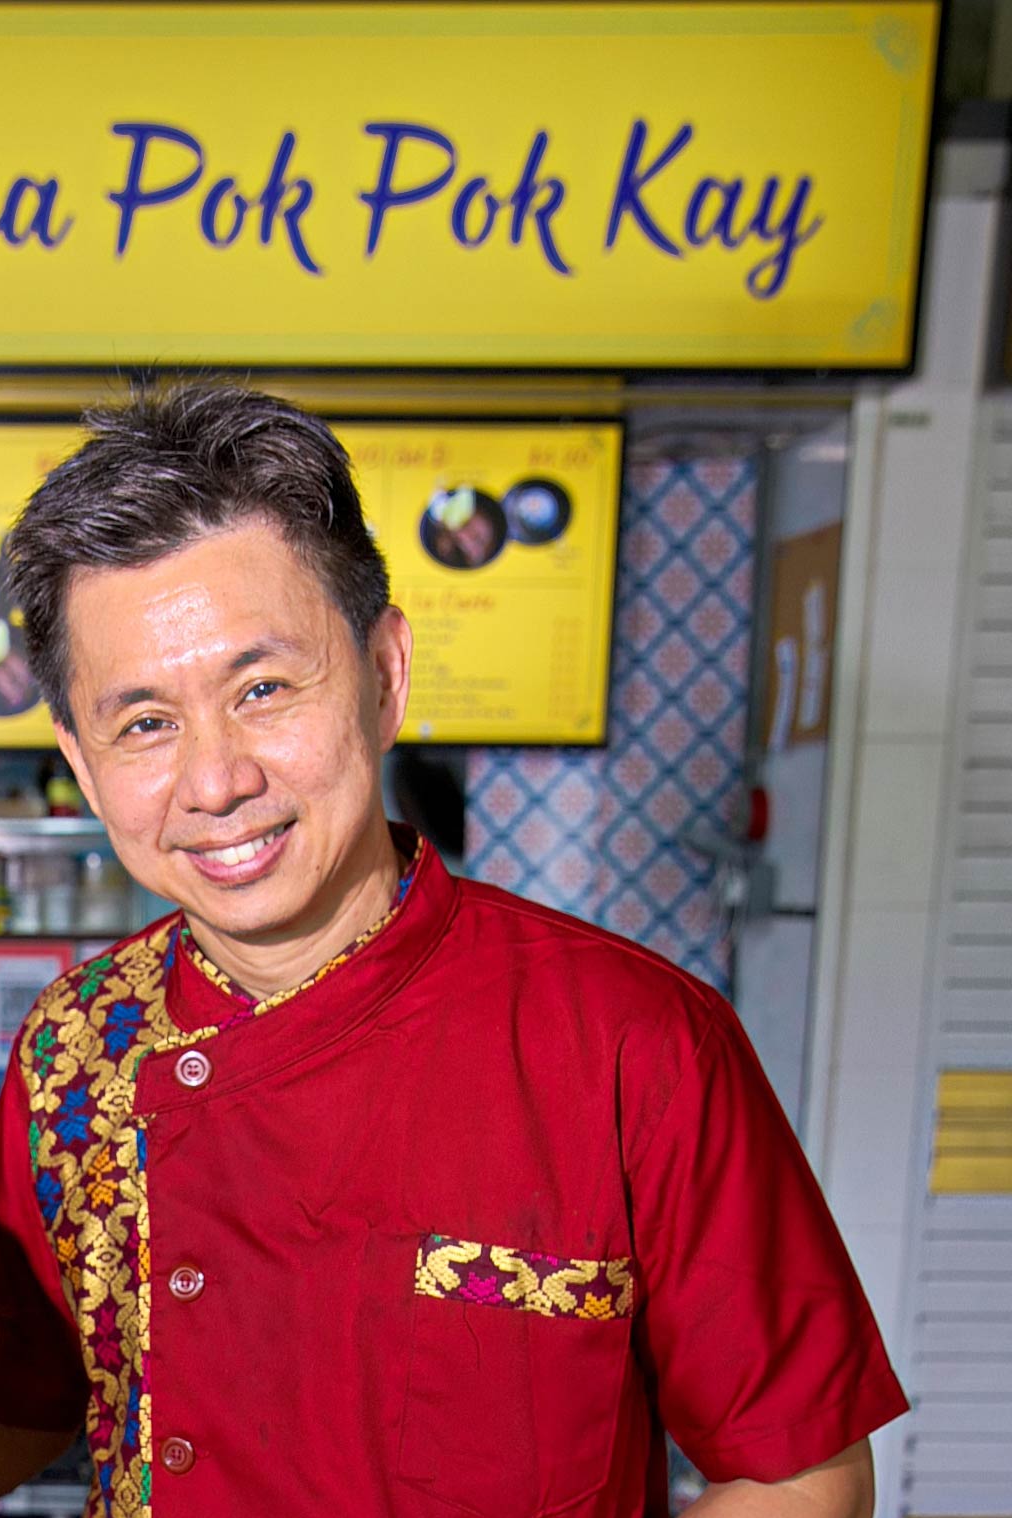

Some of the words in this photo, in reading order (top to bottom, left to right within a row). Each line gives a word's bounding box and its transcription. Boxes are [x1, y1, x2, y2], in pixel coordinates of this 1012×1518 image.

[108, 121, 323, 276] Pok
[359, 121, 575, 276] Pok
[604, 118, 824, 300] Kay
